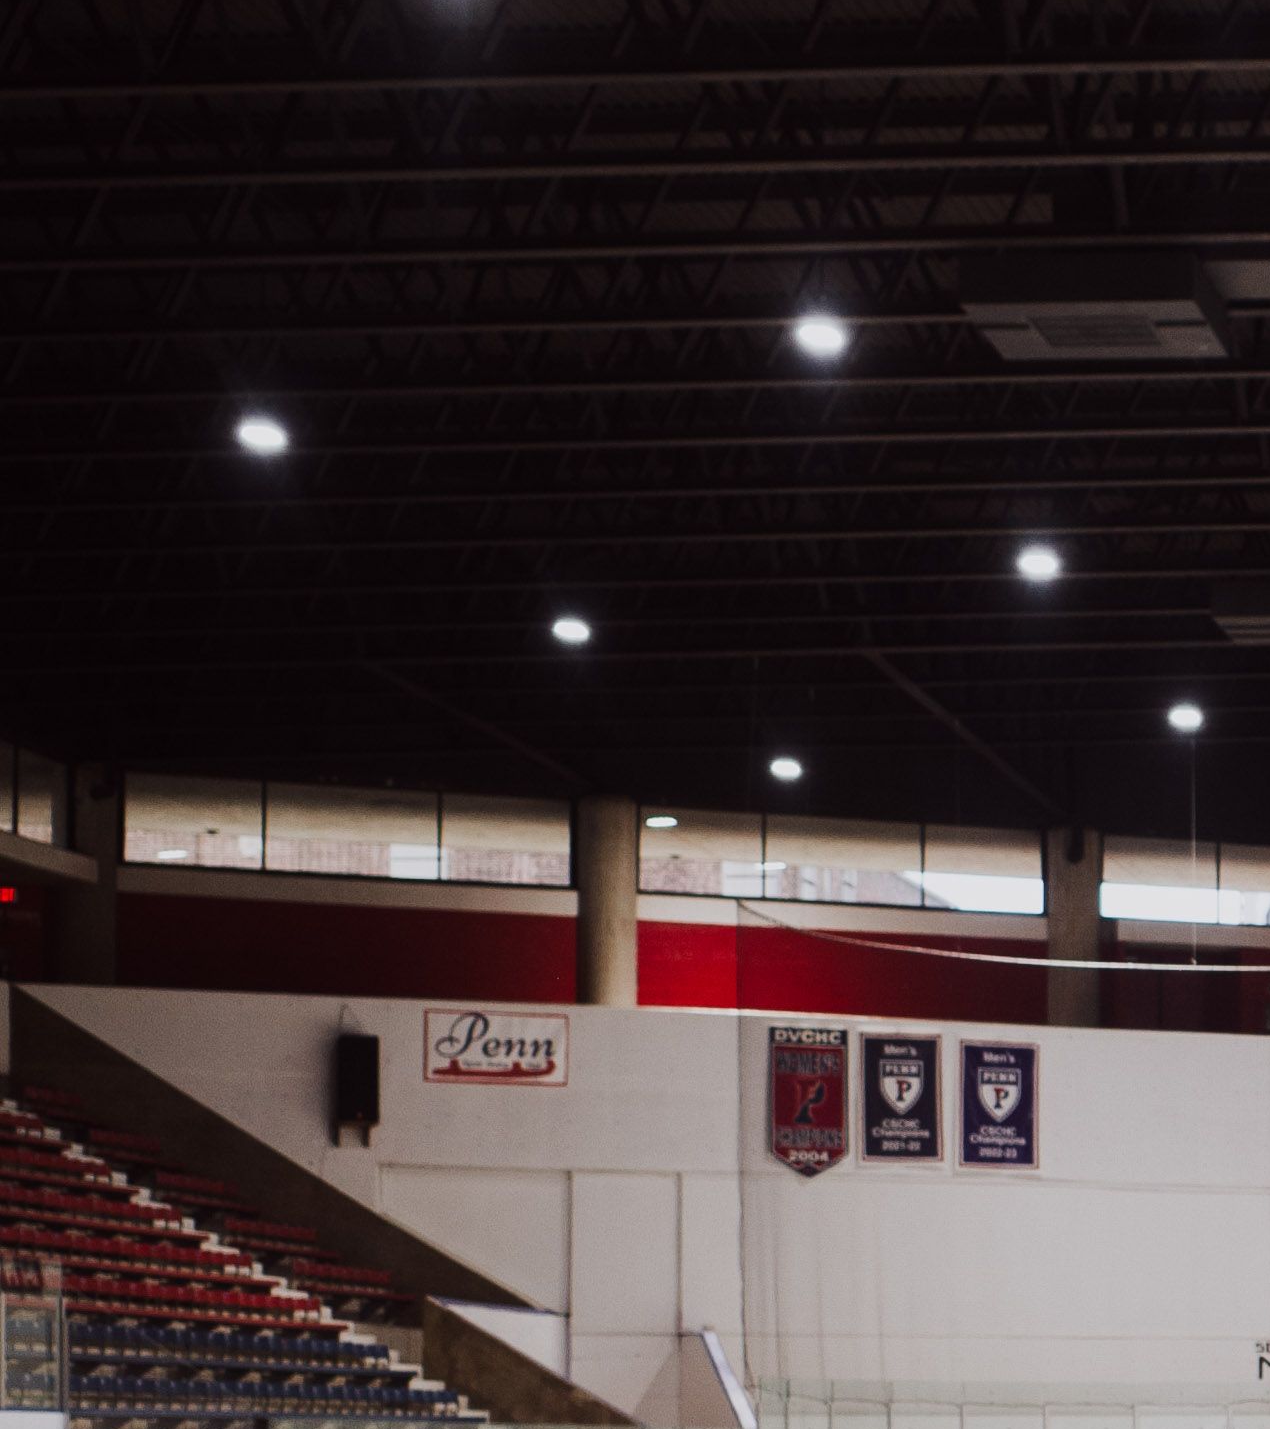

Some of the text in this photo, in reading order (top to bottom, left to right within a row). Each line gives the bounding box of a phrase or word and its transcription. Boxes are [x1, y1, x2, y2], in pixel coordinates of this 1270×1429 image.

[435, 1012, 555, 1058] Penn
[774, 1030, 841, 1044] DVCHC
[884, 1045, 916, 1056] Men's
[983, 1052, 1015, 1063] Men's
[885, 1064, 919, 1074] PENN
[983, 1072, 1017, 1082] PENN
[788, 1149, 830, 1162] 2004
